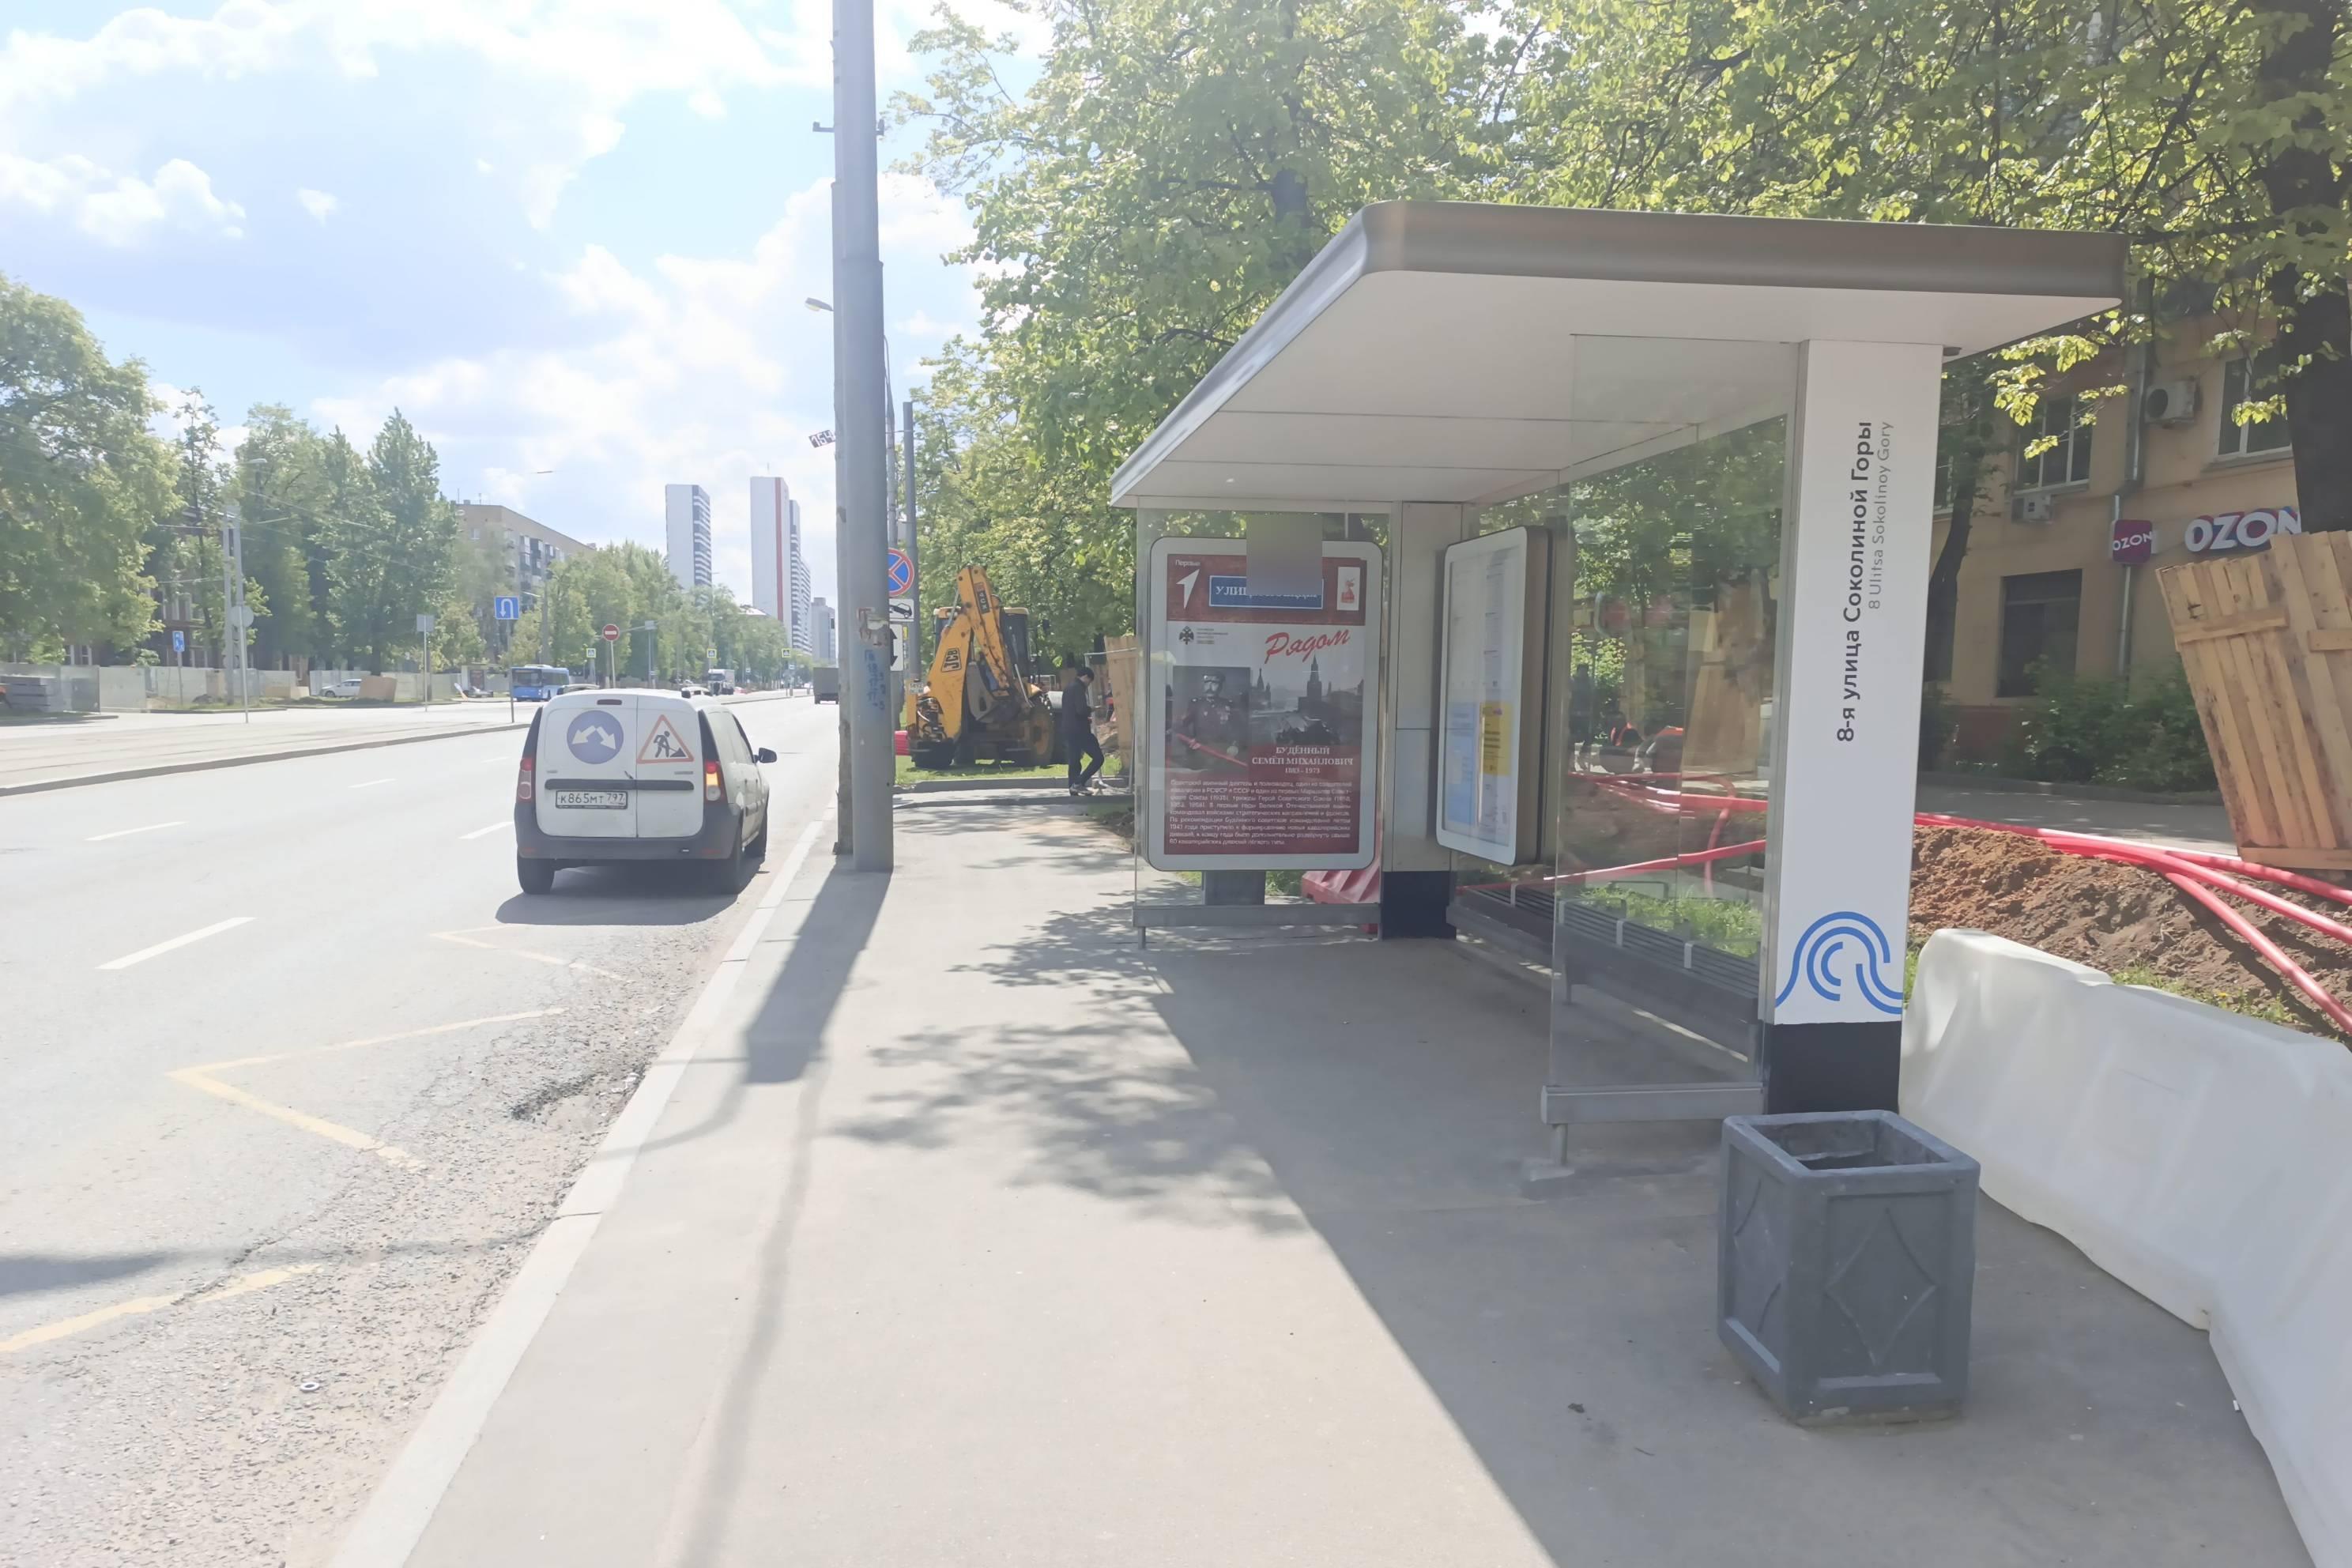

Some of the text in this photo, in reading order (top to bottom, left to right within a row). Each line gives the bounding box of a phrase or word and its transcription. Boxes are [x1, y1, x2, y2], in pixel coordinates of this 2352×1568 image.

[1868, 421, 1894, 609] 8 Ulitsa Sokolinoy Gory
[2184, 509, 2301, 552] OZON
[2113, 530, 2153, 551] OZON
[1837, 422, 1874, 741] 8-я улица Соколиной Горы
[944, 650, 959, 669] JCB
[1265, 629, 1351, 664] Рядом
[607, 793, 624, 802] 797
